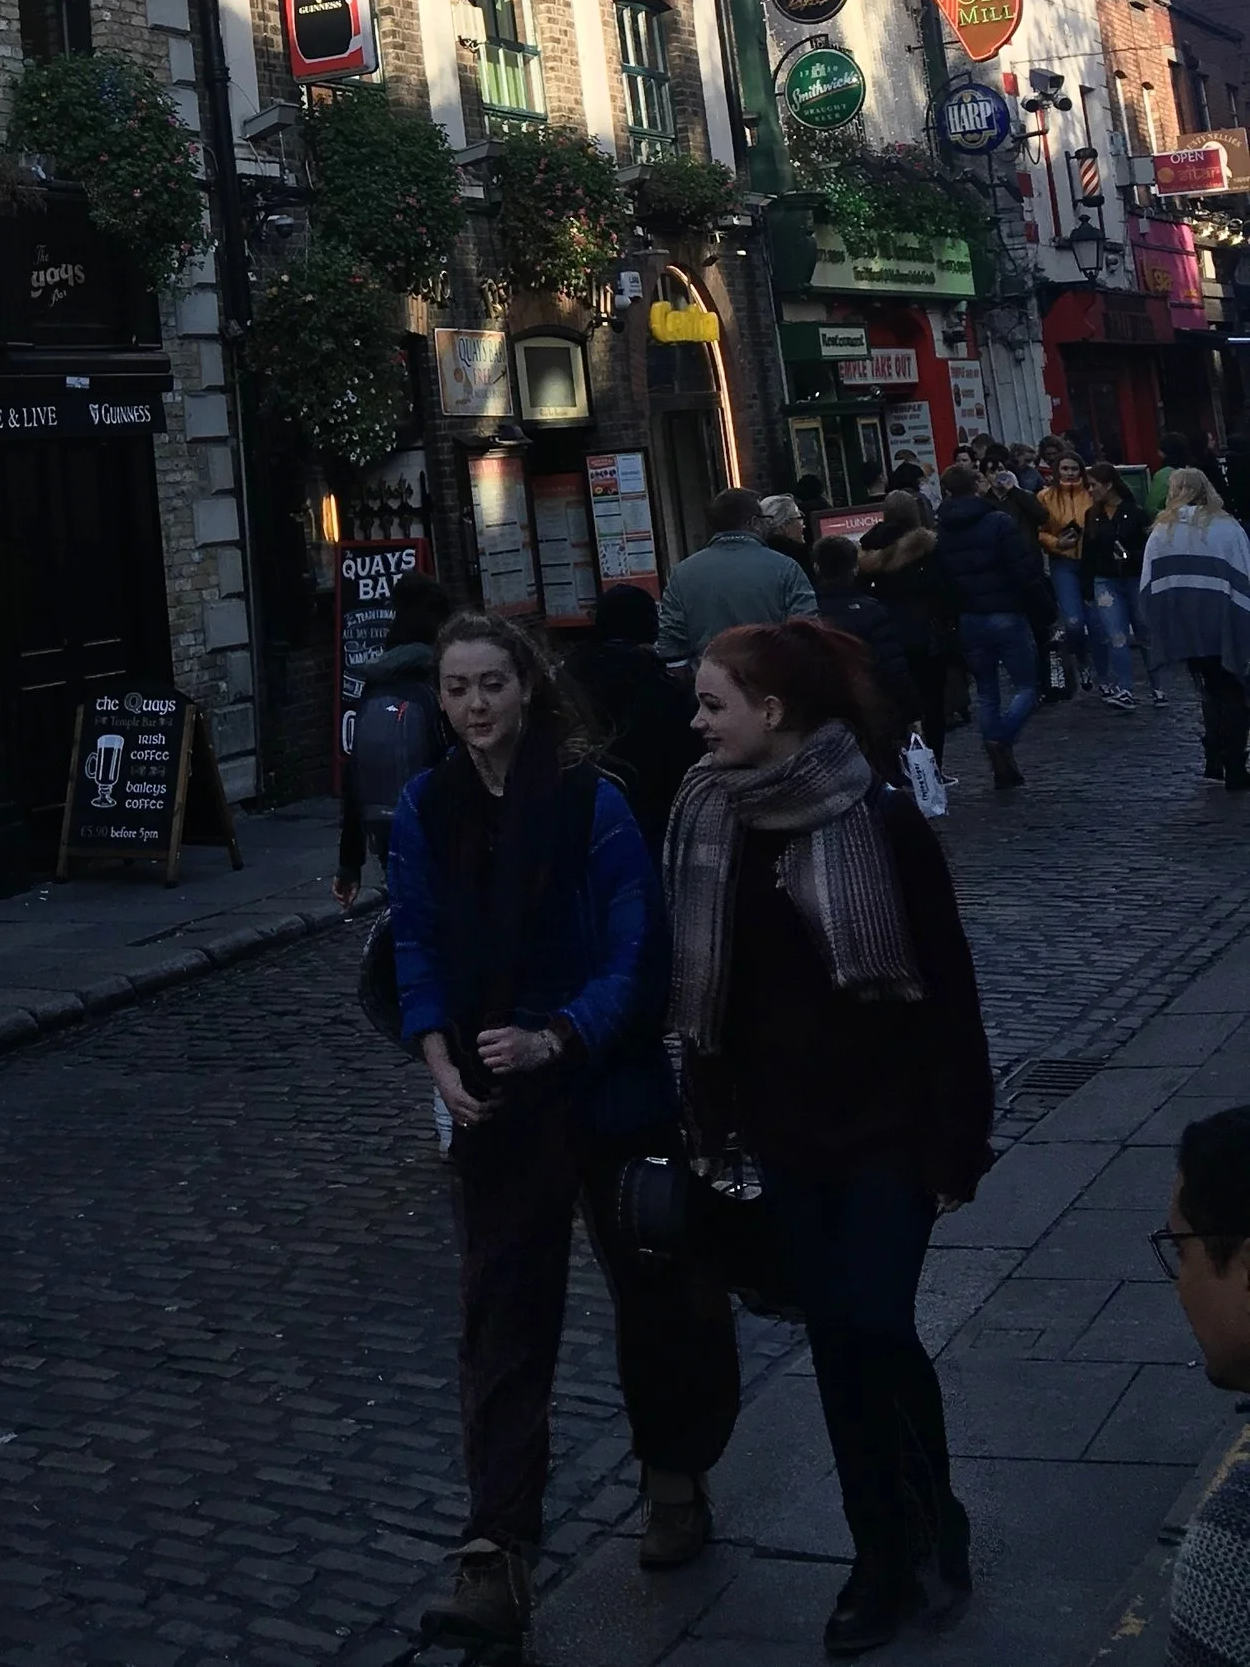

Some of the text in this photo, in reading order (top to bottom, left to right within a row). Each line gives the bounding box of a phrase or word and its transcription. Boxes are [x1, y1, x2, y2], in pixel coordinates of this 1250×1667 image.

[299, 0, 342, 14] GUINNESS
[958, 5, 1016, 26] MILL
[803, 103, 847, 116] DRAUGHT
[948, 102, 991, 133] HARP
[1170, 152, 1204, 164] OPEN
[839, 359, 867, 379] EMPLE
[895, 354, 912, 377] OUT
[8, 408, 21, 429] &
[24, 406, 58, 428] LIVE
[102, 403, 152, 425] GUINNESS
[846, 516, 878, 529] LUNCH
[342, 548, 416, 581] QUAYS
[123, 692, 176, 715] Quays
[111, 716, 156, 730] Temple Bar
[110, 826, 137, 839] before
[138, 827, 159, 842] 5pm
